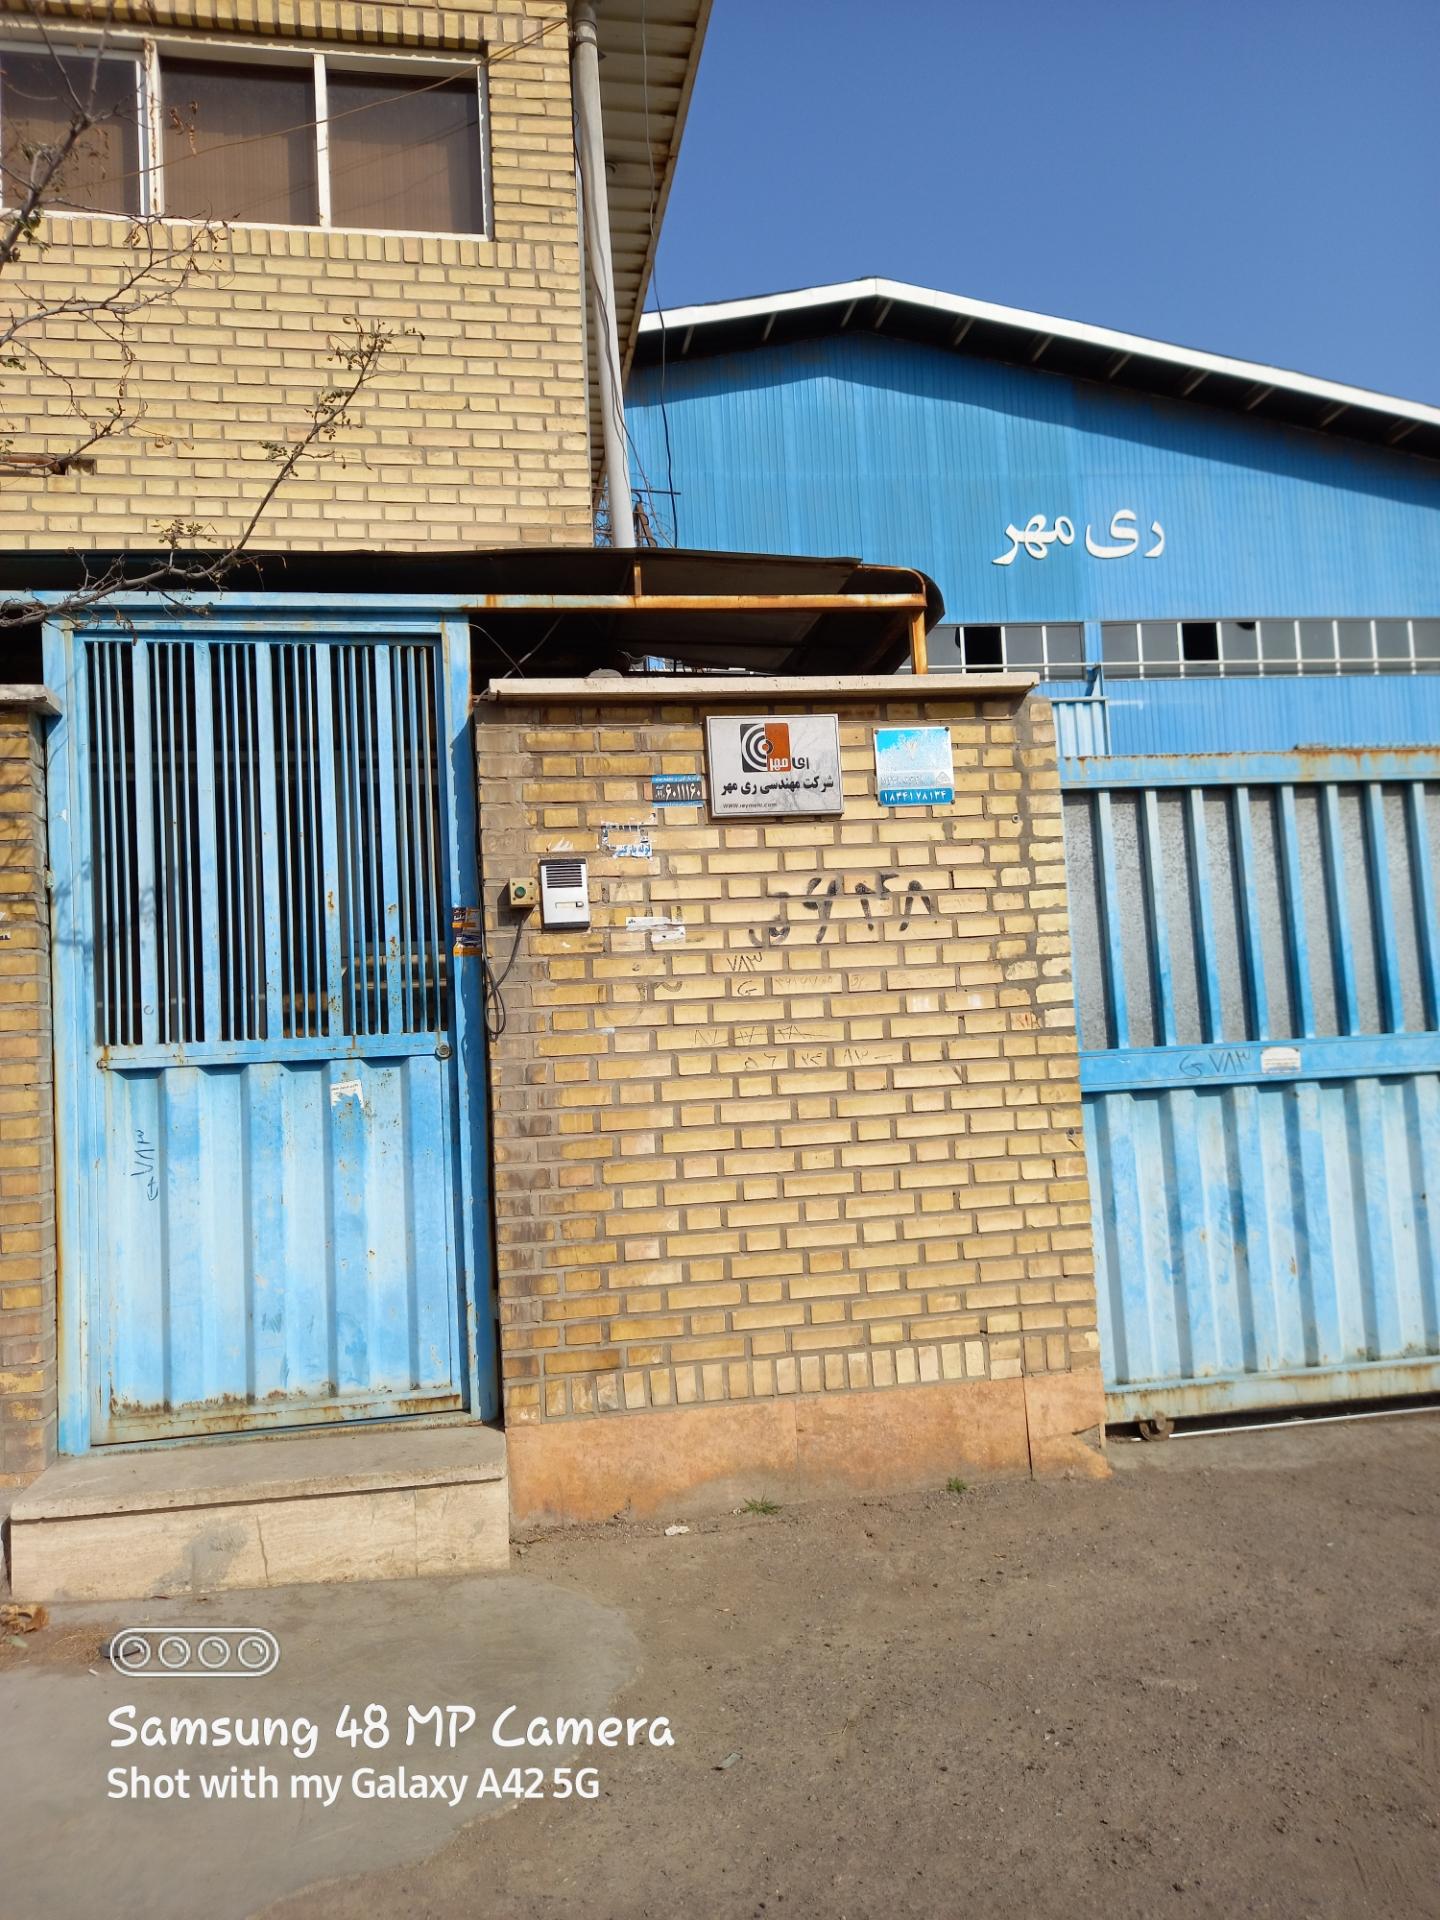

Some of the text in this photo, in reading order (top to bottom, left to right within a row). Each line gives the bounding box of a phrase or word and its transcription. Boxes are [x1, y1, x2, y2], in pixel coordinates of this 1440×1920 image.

[991, 509, 1166, 566] ری مهر
[721, 775, 834, 796] شرکت مهندسی ری مهر
